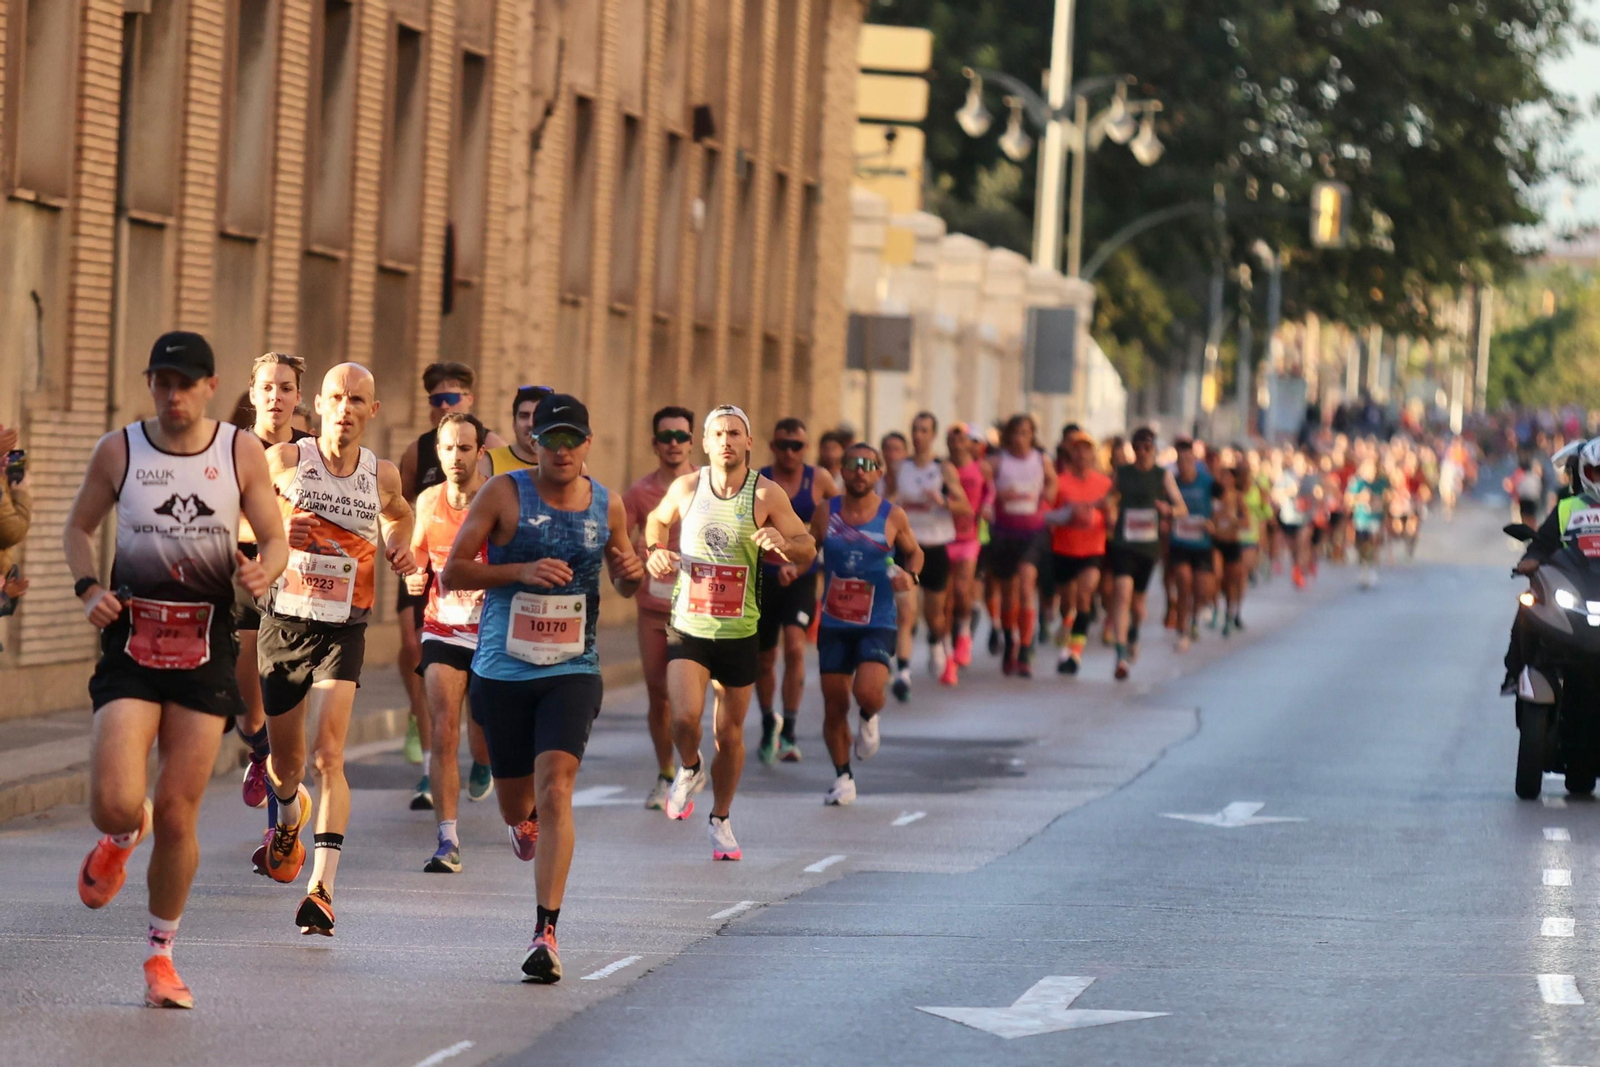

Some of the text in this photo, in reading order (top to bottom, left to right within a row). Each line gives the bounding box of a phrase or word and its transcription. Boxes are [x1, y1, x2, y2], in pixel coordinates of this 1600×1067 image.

[136, 469, 175, 480] DAUK
[335, 496, 351, 506] AGS
[353, 498, 377, 511] SOLAR
[329, 504, 340, 514] DE
[342, 507, 353, 517] LA
[708, 582, 726, 592] 519
[530, 620, 567, 632] 10170
